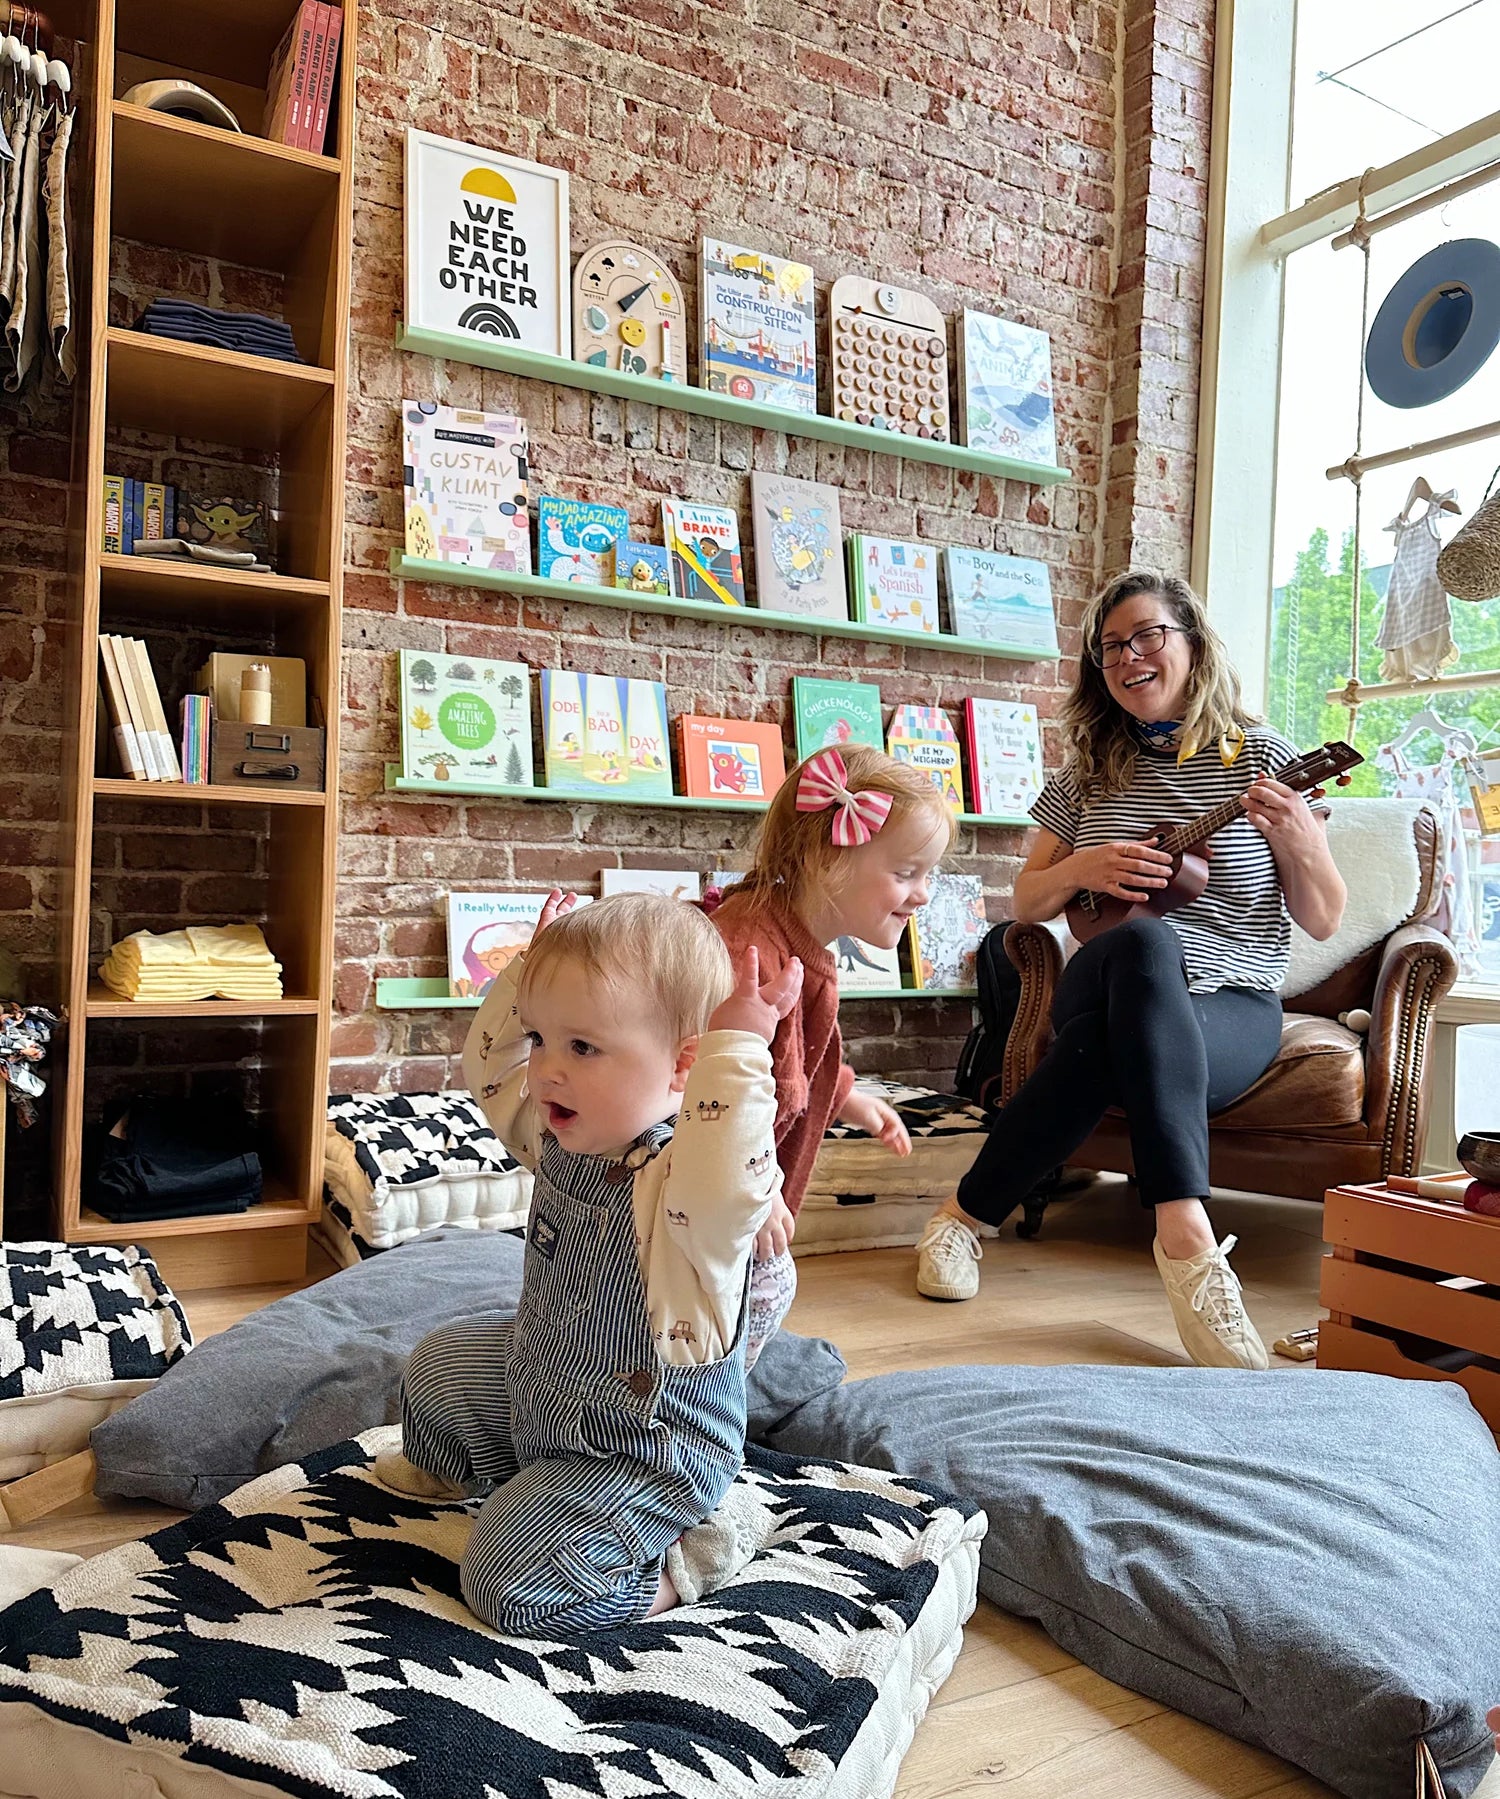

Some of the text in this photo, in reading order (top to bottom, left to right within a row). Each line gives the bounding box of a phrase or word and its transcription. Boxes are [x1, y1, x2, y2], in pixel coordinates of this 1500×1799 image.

[300, 29, 311, 68] MAKER
[312, 33, 323, 68] MAKER
[325, 37, 336, 73] MAKER
[294, 68, 305, 97] CAMP
[308, 72, 318, 100] CAMP
[320, 75, 330, 104] CAMP
[463, 199, 514, 231] WE
[450, 220, 527, 257] NEED
[448, 244, 528, 282] EACH
[439, 267, 538, 309] OTHER
[887, 291, 894, 303] 5
[716, 293, 802, 324] CONSTRUCTION
[764, 316, 787, 331] SITE
[430, 452, 512, 478] GUSTAV
[441, 476, 501, 499] KLIMT
[105, 502, 120, 534] MARVEL
[560, 502, 579, 515] DAD
[564, 510, 627, 529] AMAZING!
[679, 509, 731, 525] I Am So
[146, 508, 161, 540] MARVEL
[972, 556, 996, 575] Boy
[995, 570, 1010, 579] and
[1010, 572, 1023, 581] the
[1024, 573, 1044, 587] Sea
[879, 574, 924, 594] Spanish
[447, 708, 487, 726] AMAZING
[552, 701, 580, 713] ODE
[804, 697, 874, 723] CHICKENOLOGY
[456, 723, 480, 738] TREES
[588, 717, 621, 733] BAD
[691, 723, 705, 733] my
[706, 724, 725, 736] day
[629, 735, 660, 751] DAY
[922, 747, 944, 756] BE MY
[913, 755, 954, 766] NEIGHBOR?
[458, 903, 461, 911] I
[464, 903, 495, 915] Really
[497, 903, 525, 913] Want
[527, 904, 538, 913] to
